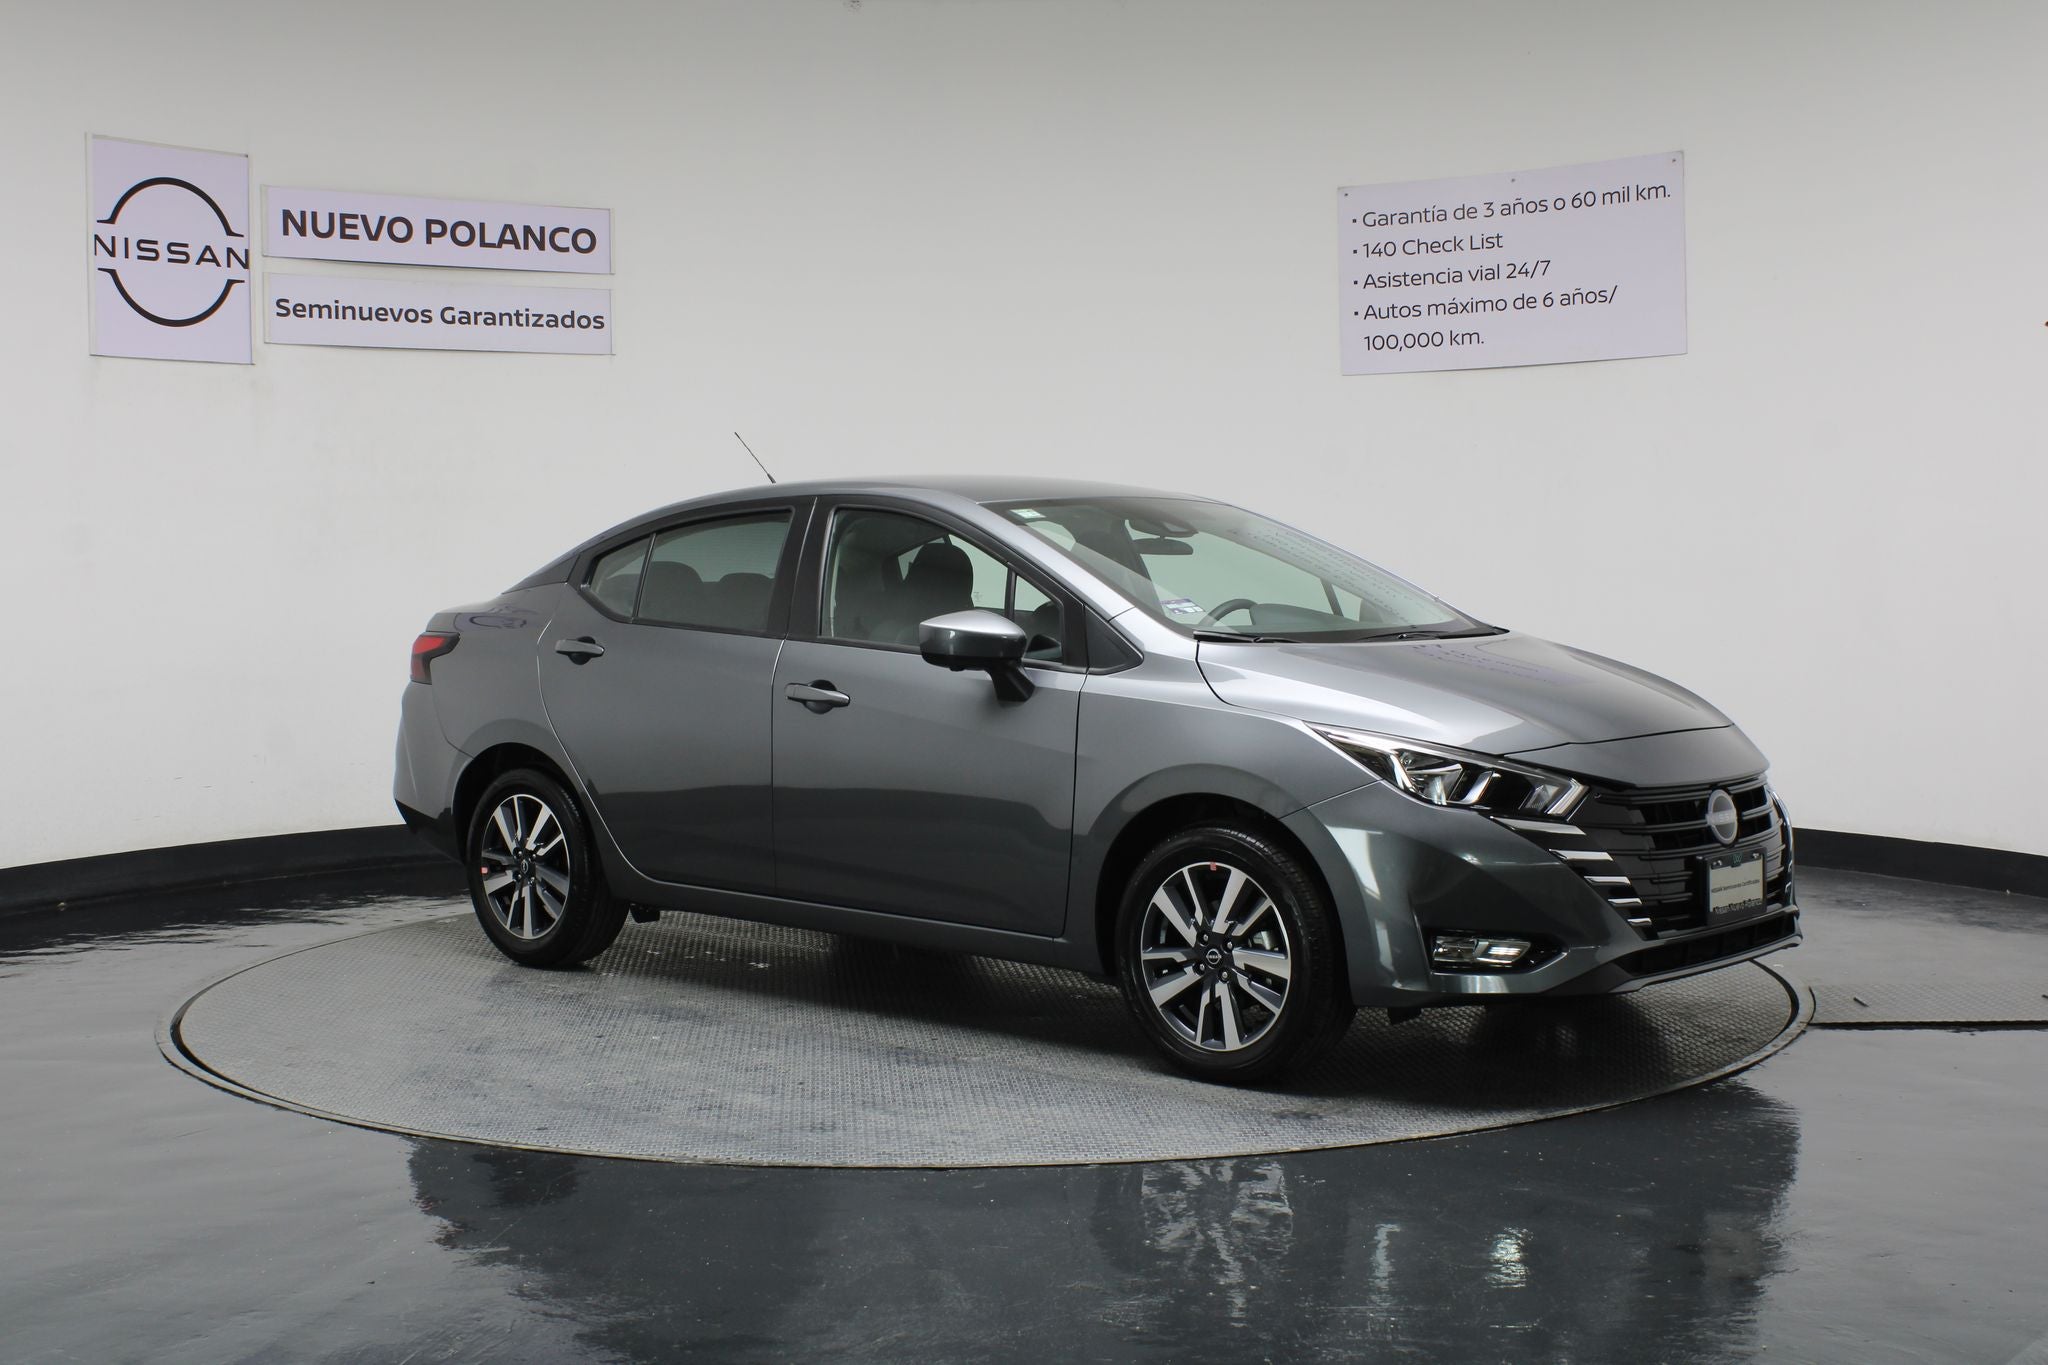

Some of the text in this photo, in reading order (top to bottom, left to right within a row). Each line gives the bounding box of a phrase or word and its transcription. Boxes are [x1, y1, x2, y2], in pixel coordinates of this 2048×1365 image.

[1362, 184, 1672, 228] Garantía de 3 años o 60 mil km.
[282, 208, 597, 254] NUEVO POLANCO
[1362, 233, 1504, 259] 140 Check List
[94, 233, 249, 270] NISSAN
[1363, 259, 1551, 290] Asistencia vial 24/7
[275, 298, 605, 330] Seminuevos Garantizados
[1363, 284, 1618, 321] Autos máximo de 6 años/
[1363, 329, 1485, 352] 100,000 km.
